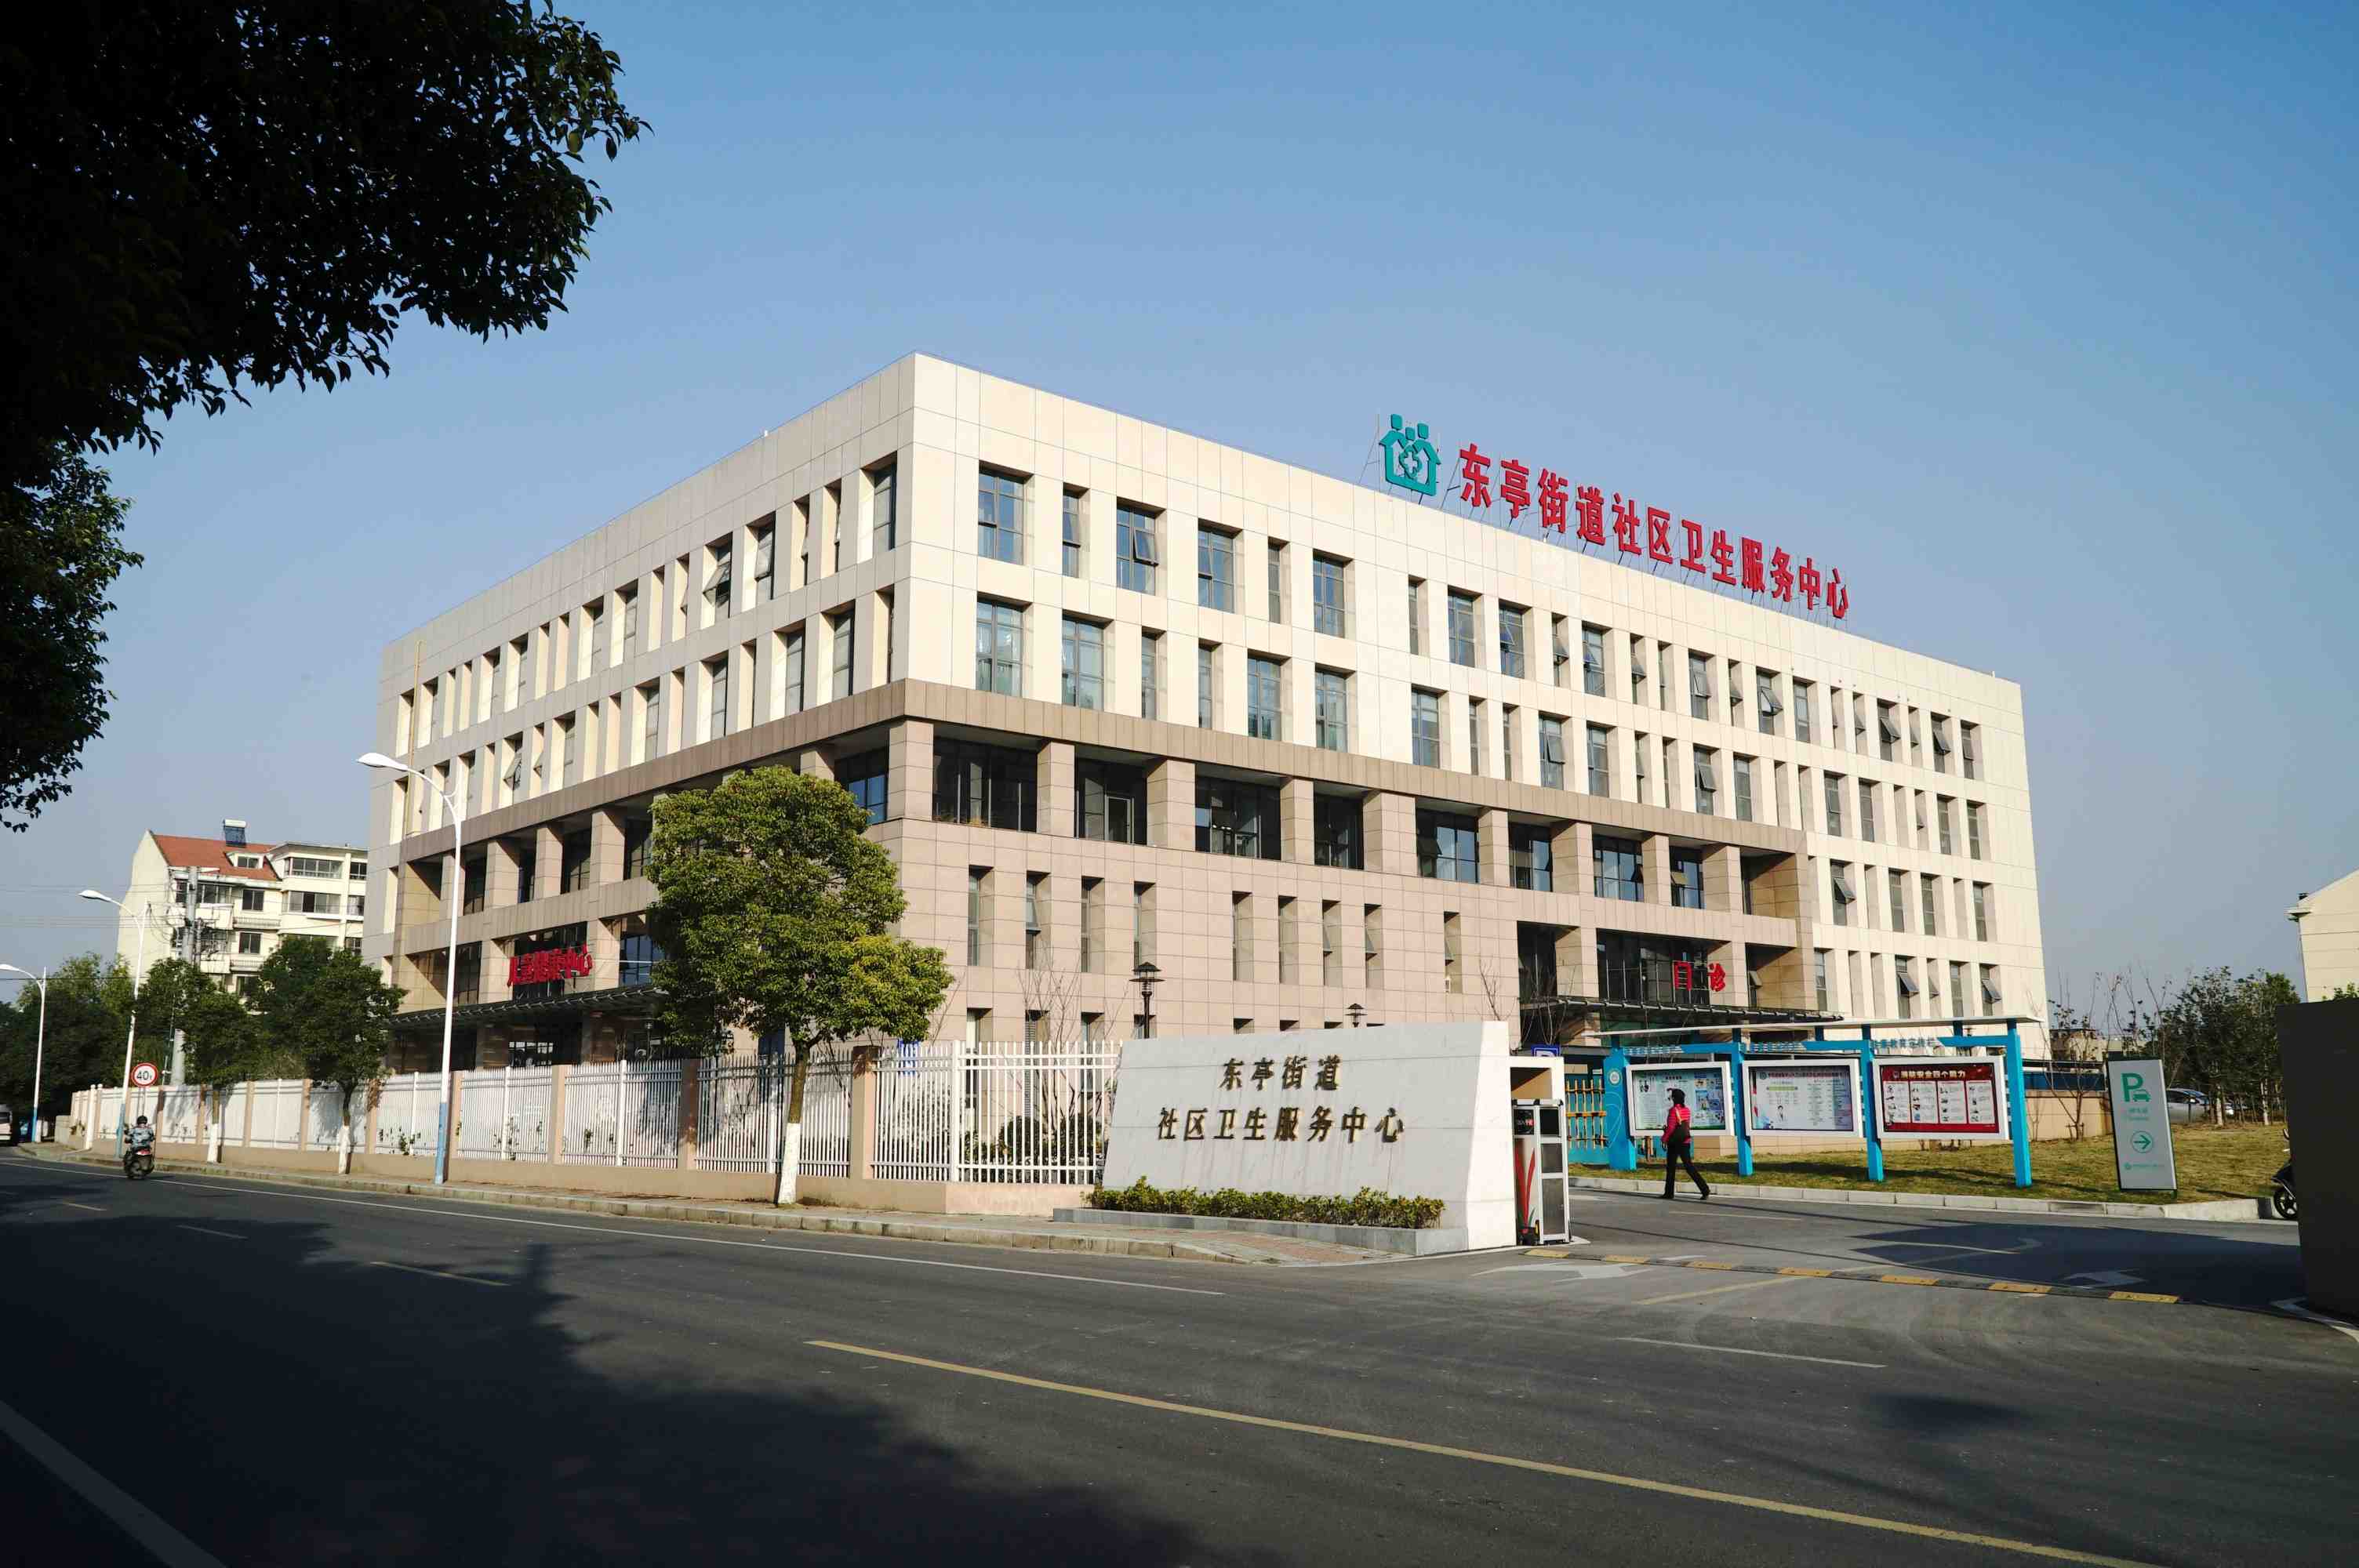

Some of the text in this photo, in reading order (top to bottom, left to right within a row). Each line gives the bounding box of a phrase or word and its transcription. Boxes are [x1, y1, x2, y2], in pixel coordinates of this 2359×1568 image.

[1459, 443, 1849, 619] 东亭街道社区卫生服务中心
[1672, 961, 1726, 992] 门诊
[1219, 1054, 1343, 1091] 东亭街道
[2121, 1073, 2143, 1102] P
[1158, 1105, 1405, 1144] 社区卫生服务中心
